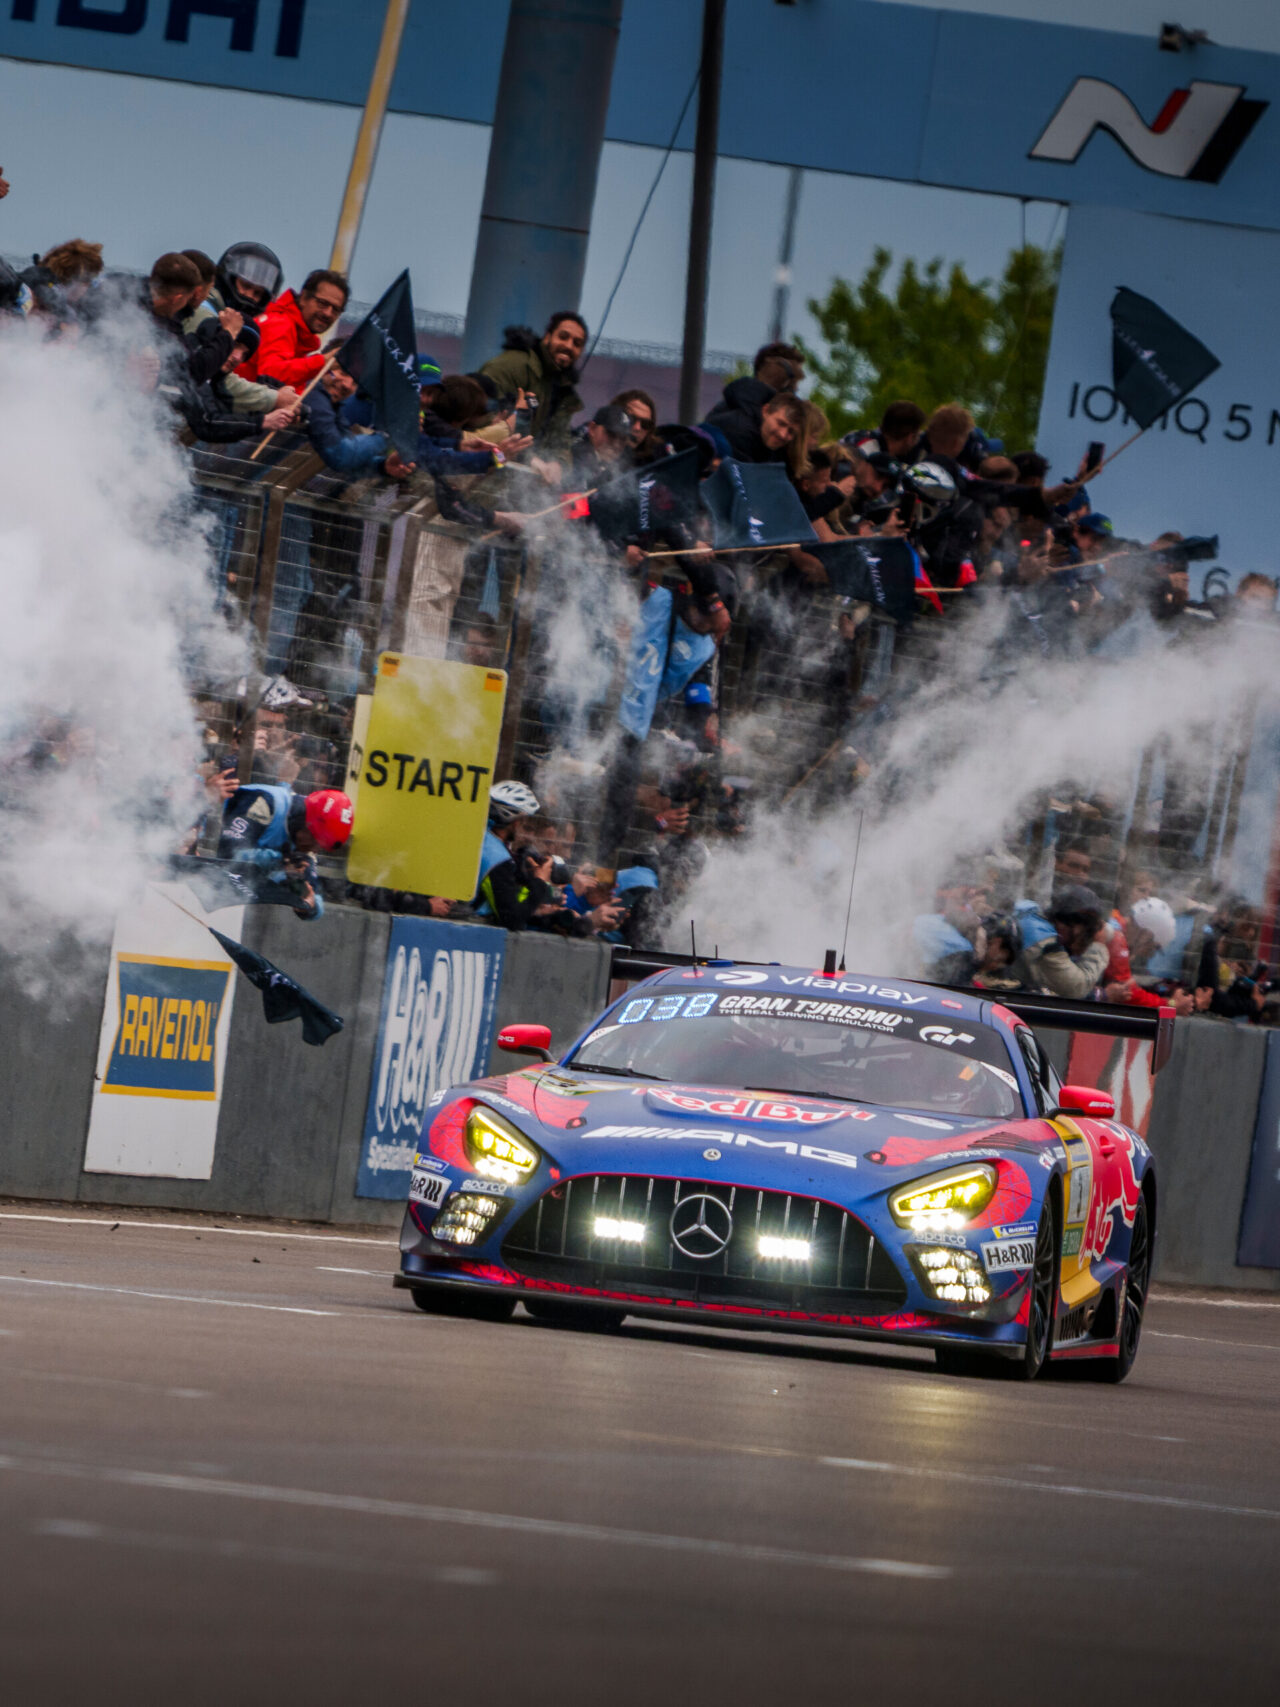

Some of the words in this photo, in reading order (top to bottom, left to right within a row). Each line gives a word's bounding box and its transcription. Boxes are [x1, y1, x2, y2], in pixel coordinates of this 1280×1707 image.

[1069, 381, 1211, 444] IOIQ
[1223, 403, 1252, 441] 5
[365, 750, 490, 803] START
[719, 994, 792, 1012] GRAN
[777, 972, 929, 1006] viaplay
[618, 992, 719, 1025] 038
[744, 1009, 774, 1017] REAL
[777, 1010, 825, 1022] DRIVING
[827, 1016, 895, 1034] SIMULATOR
[119, 993, 214, 1062] RAVENOL
[669, 1128, 857, 1169] AMG
[985, 1244, 1021, 1267] H&R
